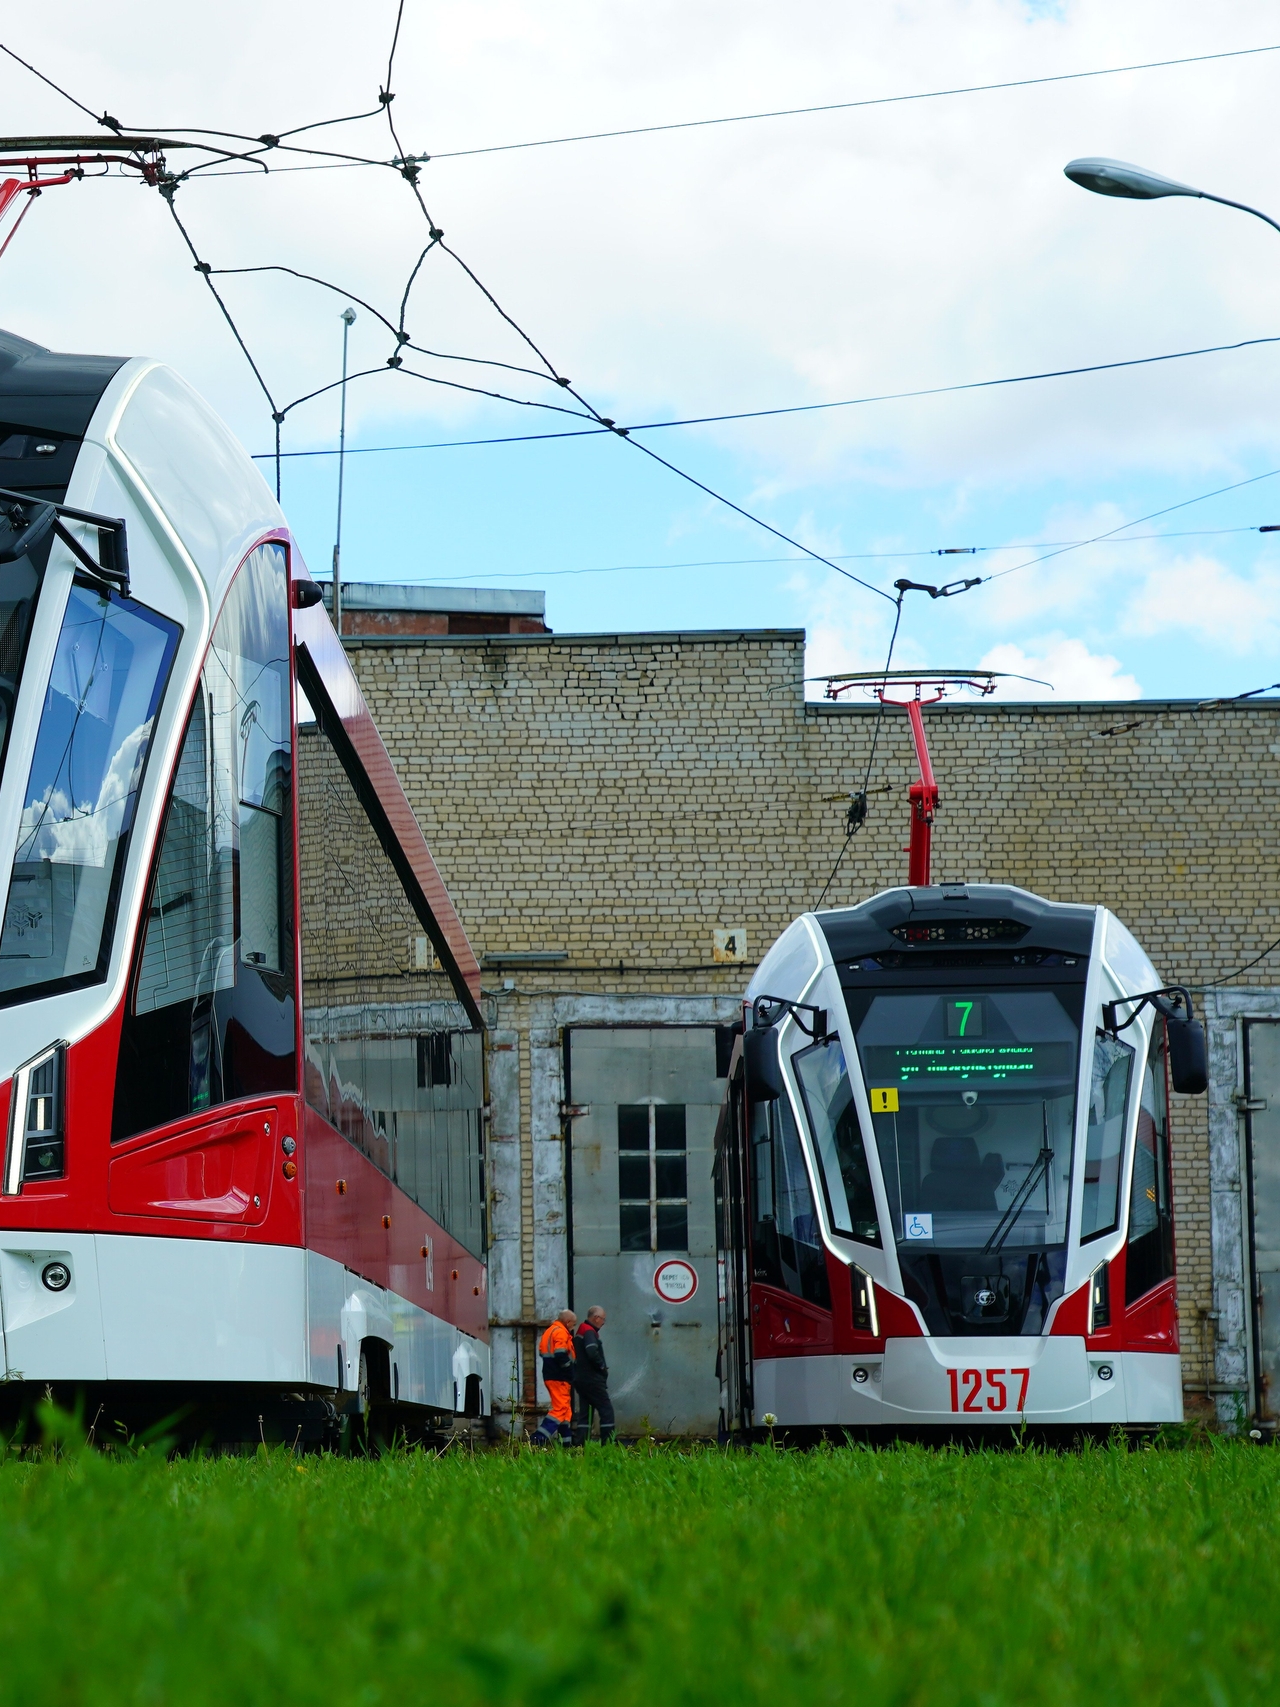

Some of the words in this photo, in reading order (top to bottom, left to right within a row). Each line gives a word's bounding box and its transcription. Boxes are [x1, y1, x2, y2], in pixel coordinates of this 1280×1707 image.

[724, 935, 737, 956] 4
[954, 1002, 973, 1036] 7
[946, 1368, 1030, 1412] 1257
